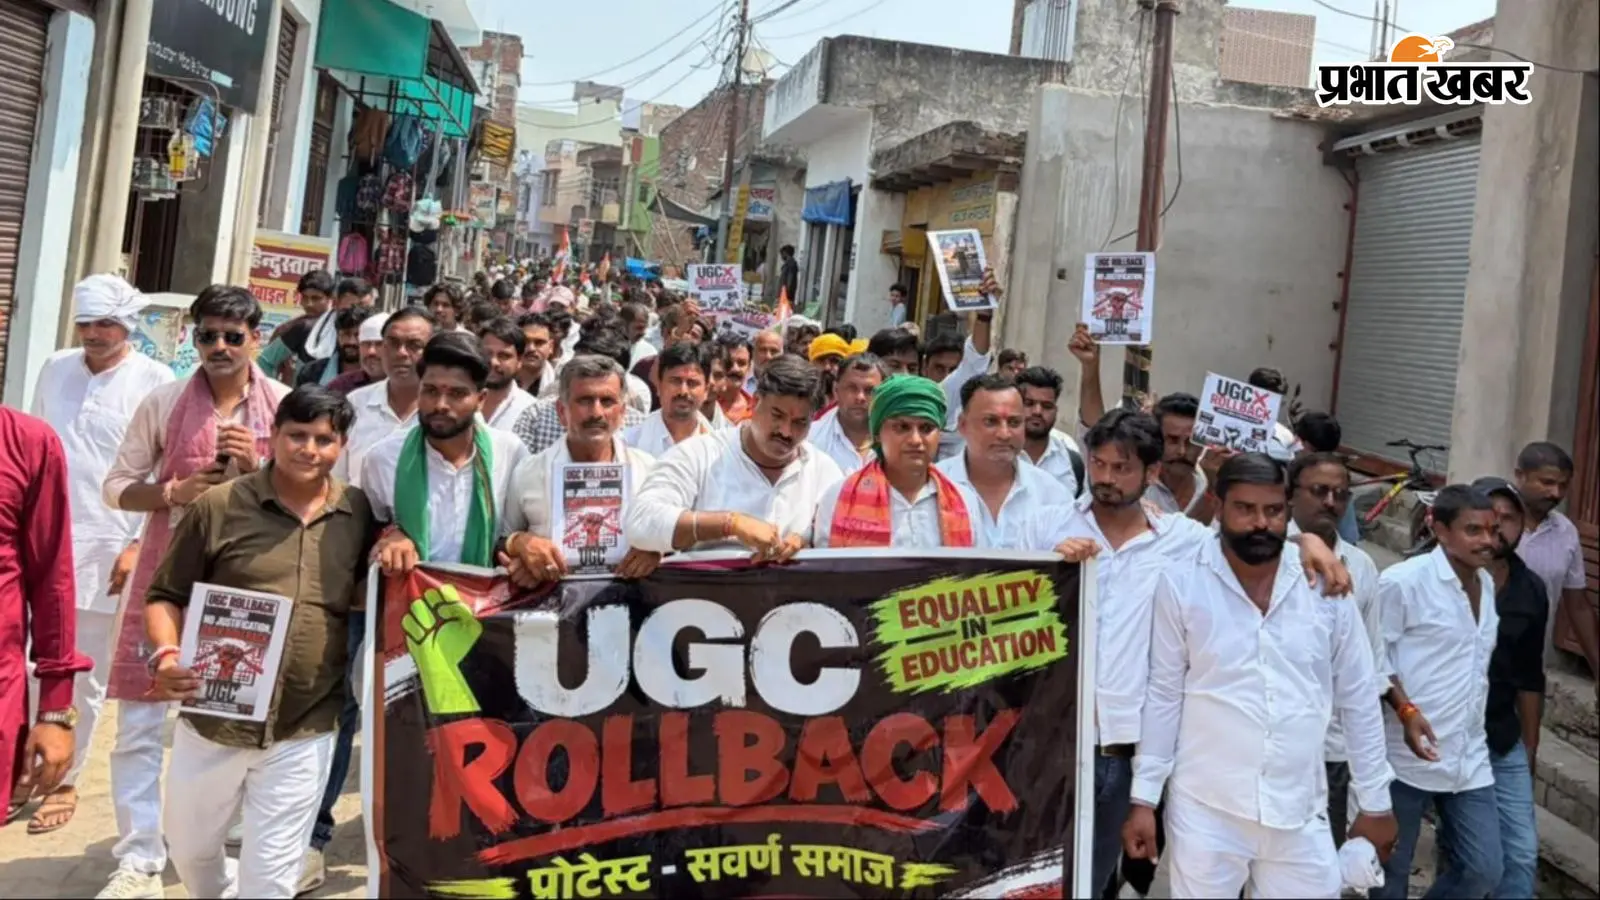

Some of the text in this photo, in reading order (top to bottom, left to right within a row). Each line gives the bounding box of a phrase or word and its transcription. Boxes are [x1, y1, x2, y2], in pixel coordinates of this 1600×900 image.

[1210, 392, 1272, 421] ROLLBACK
[578, 546, 607, 567] UGC
[208, 592, 227, 607] UGC
[229, 596, 276, 613] ROLLBACK
[898, 577, 1042, 630] EQUALITY
[960, 616, 988, 640] IN
[513, 598, 861, 717] UGC
[902, 624, 1057, 683] EDUCATION
[205, 679, 240, 702] UGC
[427, 706, 1021, 840] ROLLBACK
[528, 852, 651, 900] प्रोटेस्ट
[686, 834, 782, 882] सवर्ण
[792, 844, 895, 888] समाज
